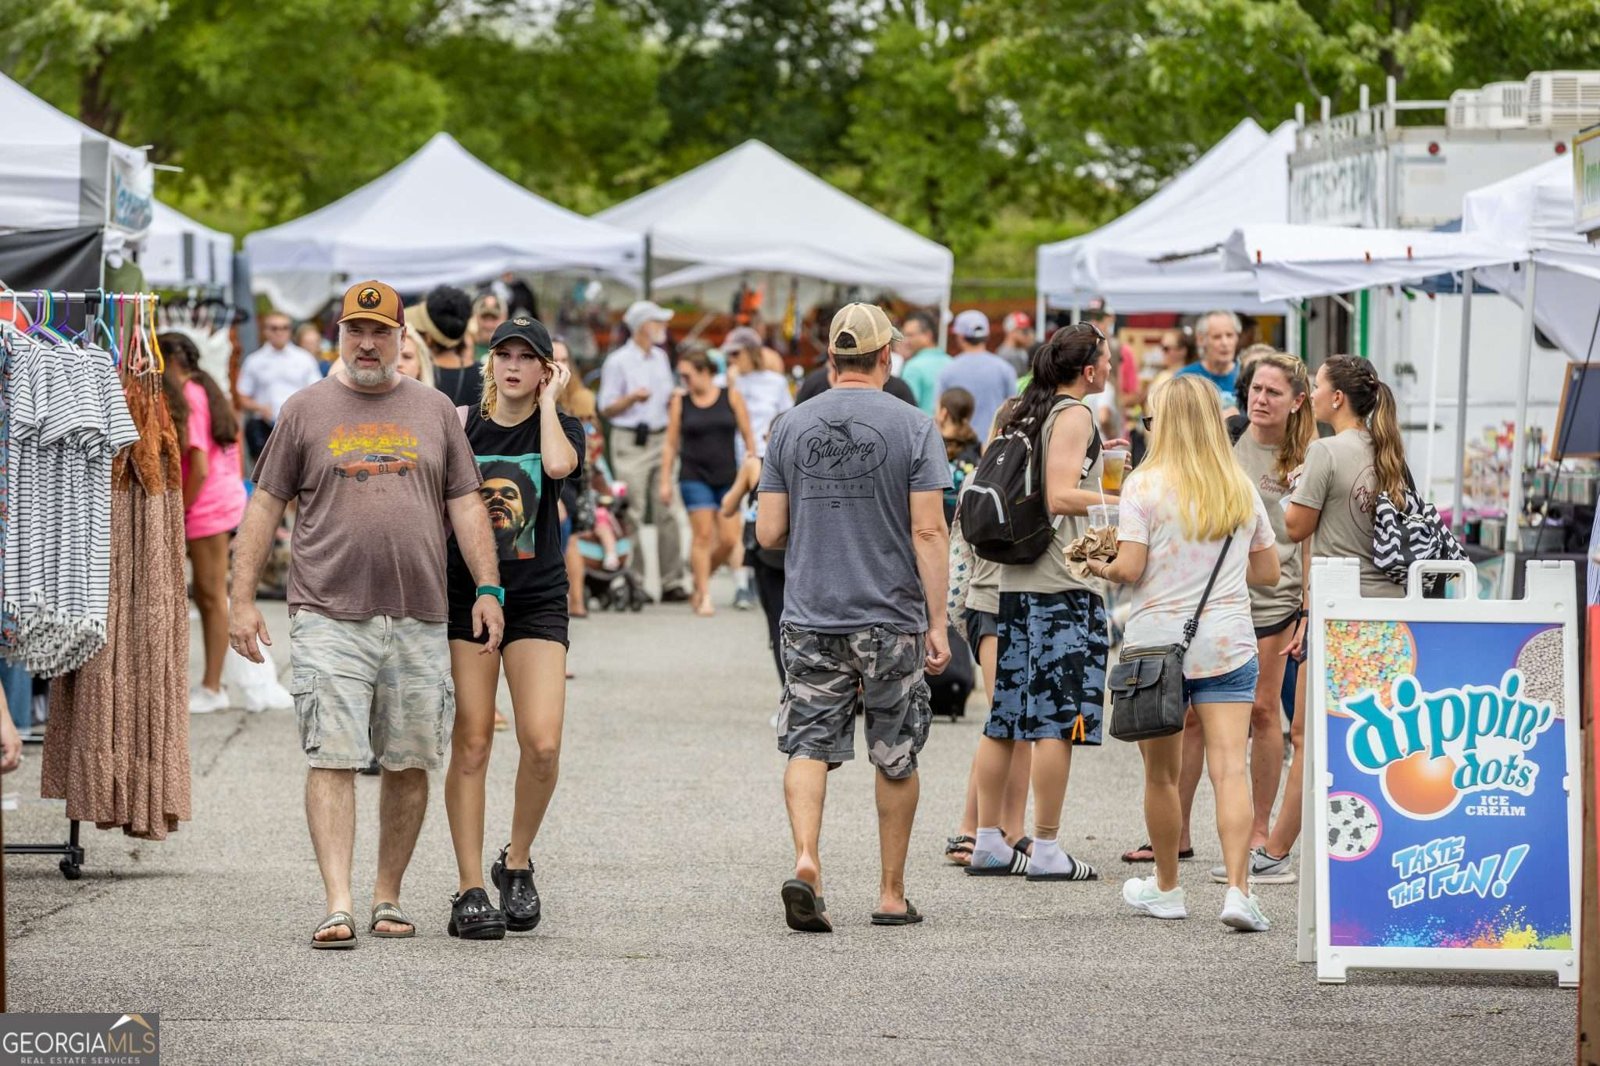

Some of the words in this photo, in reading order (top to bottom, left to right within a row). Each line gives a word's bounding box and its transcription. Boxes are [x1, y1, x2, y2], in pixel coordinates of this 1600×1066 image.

[802, 437, 876, 468] Billabong
[1454, 752, 1534, 790] dots
[1465, 806, 1526, 817] CREAM
[1480, 795, 1510, 806] ICE
[1392, 836, 1466, 879] TASTE
[1388, 877, 1426, 909] THE
